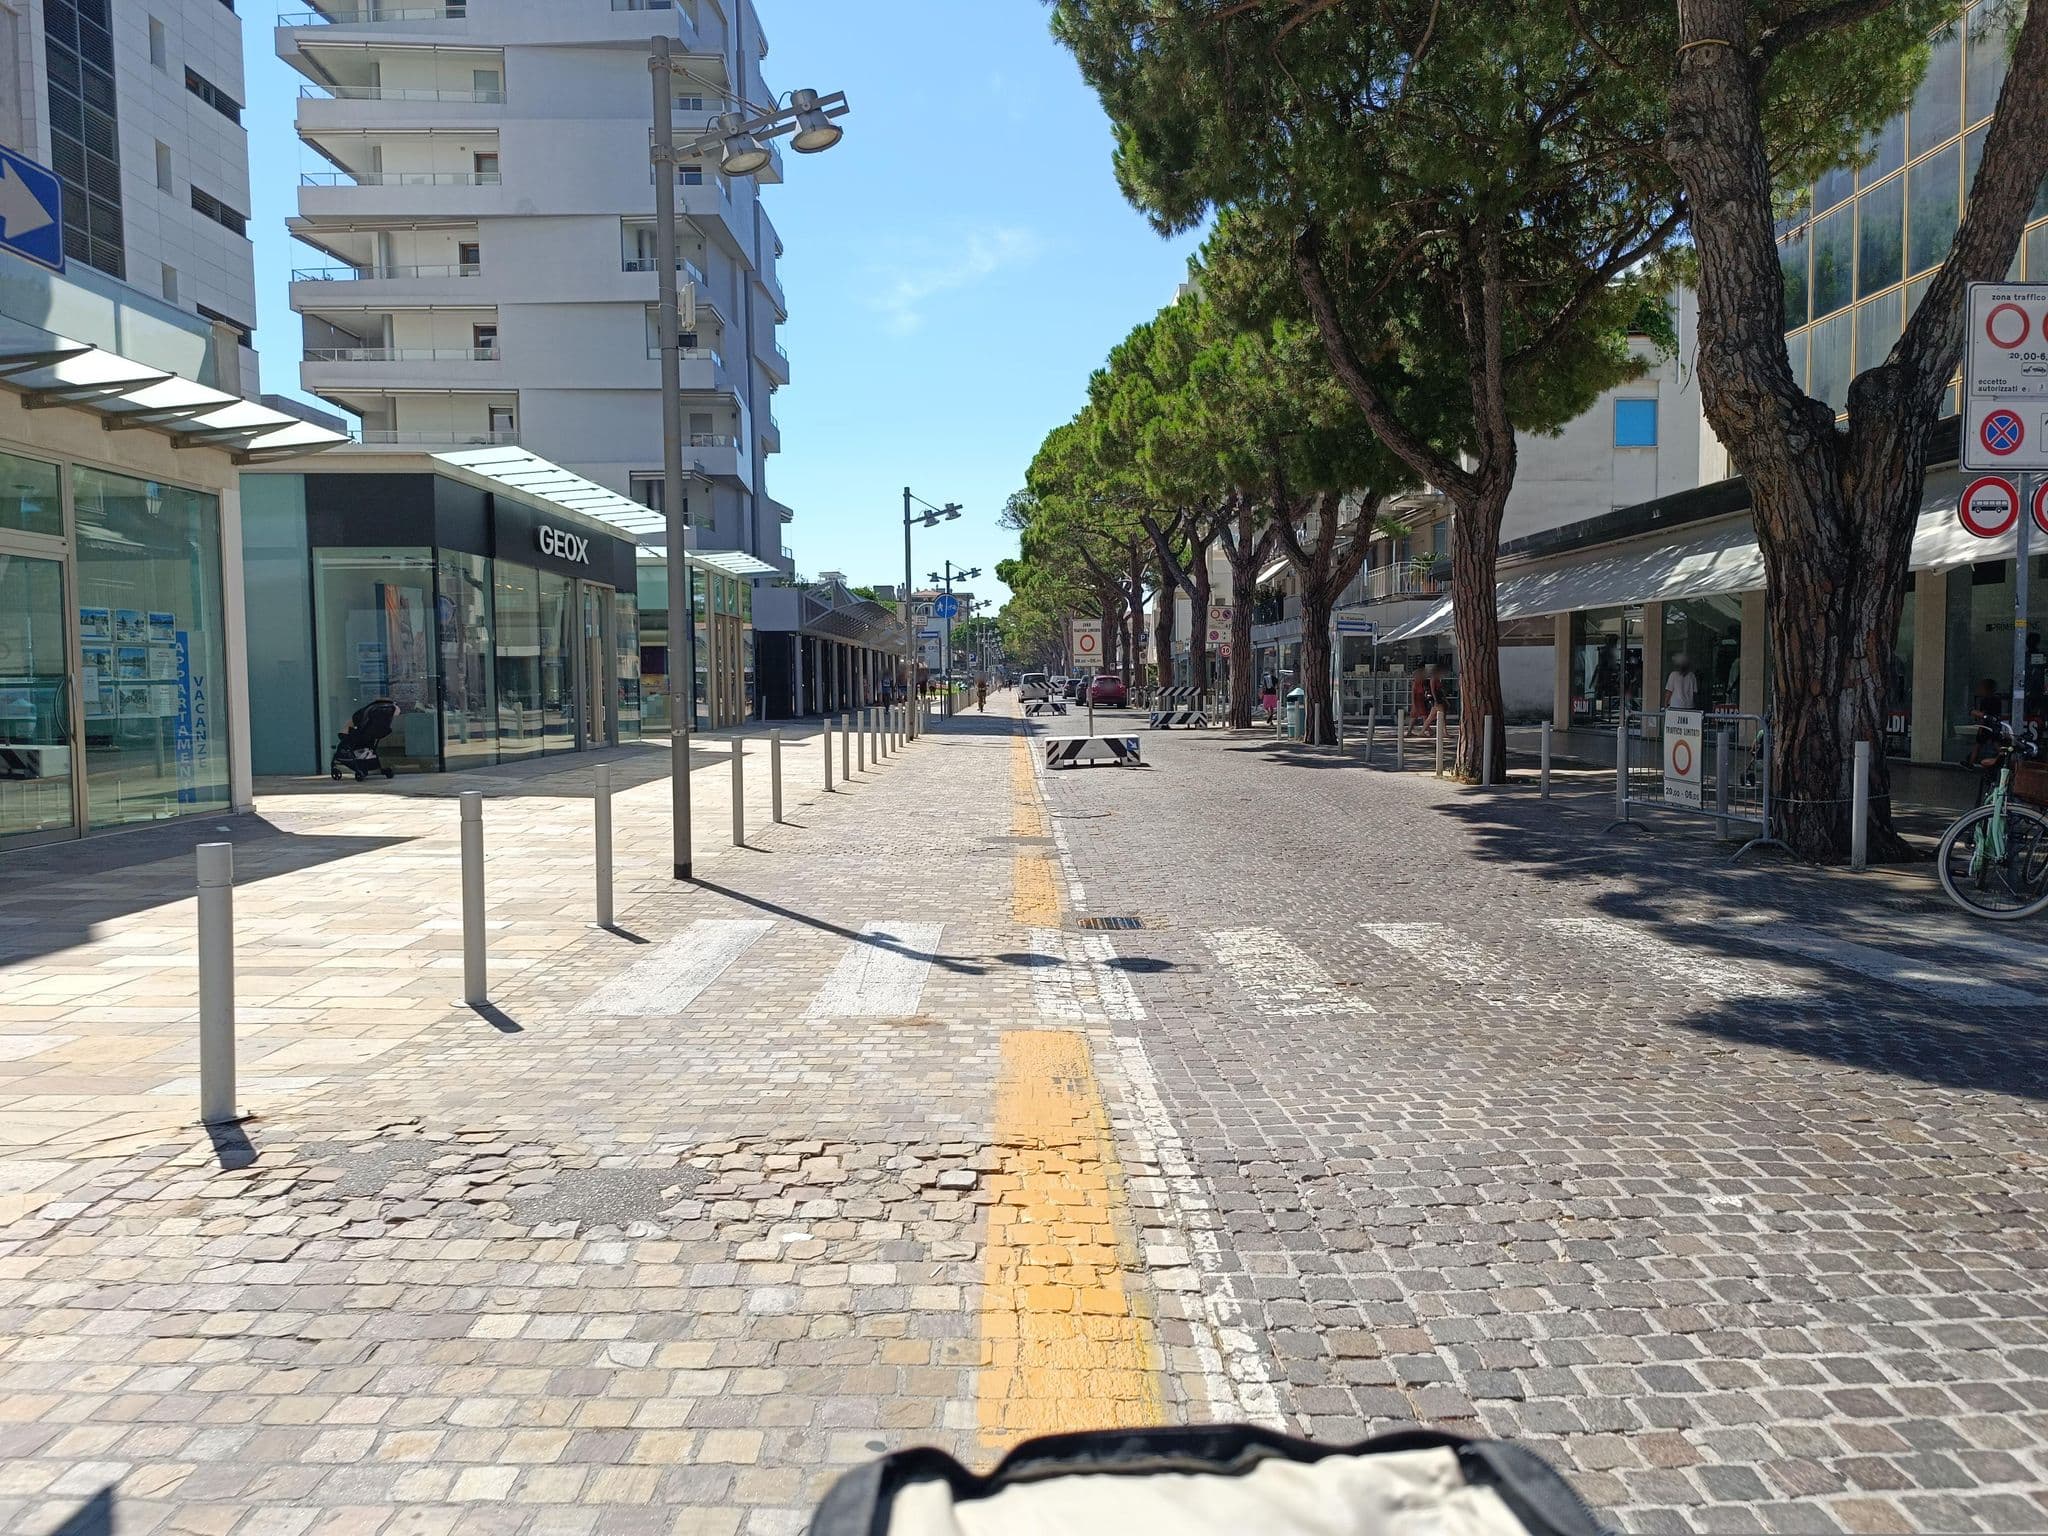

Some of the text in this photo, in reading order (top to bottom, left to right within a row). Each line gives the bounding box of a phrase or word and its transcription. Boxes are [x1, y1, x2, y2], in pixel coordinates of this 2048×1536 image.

[2014, 293, 2047, 301] traffico
[1977, 385, 2018, 393] autorizzati
[539, 525, 590, 565] GEOX
[1573, 700, 1588, 713] SALDI
[193, 675, 208, 769] VACANZE
[1886, 715, 1905, 733] LDI
[1666, 726, 1682, 736] TRAFFICO
